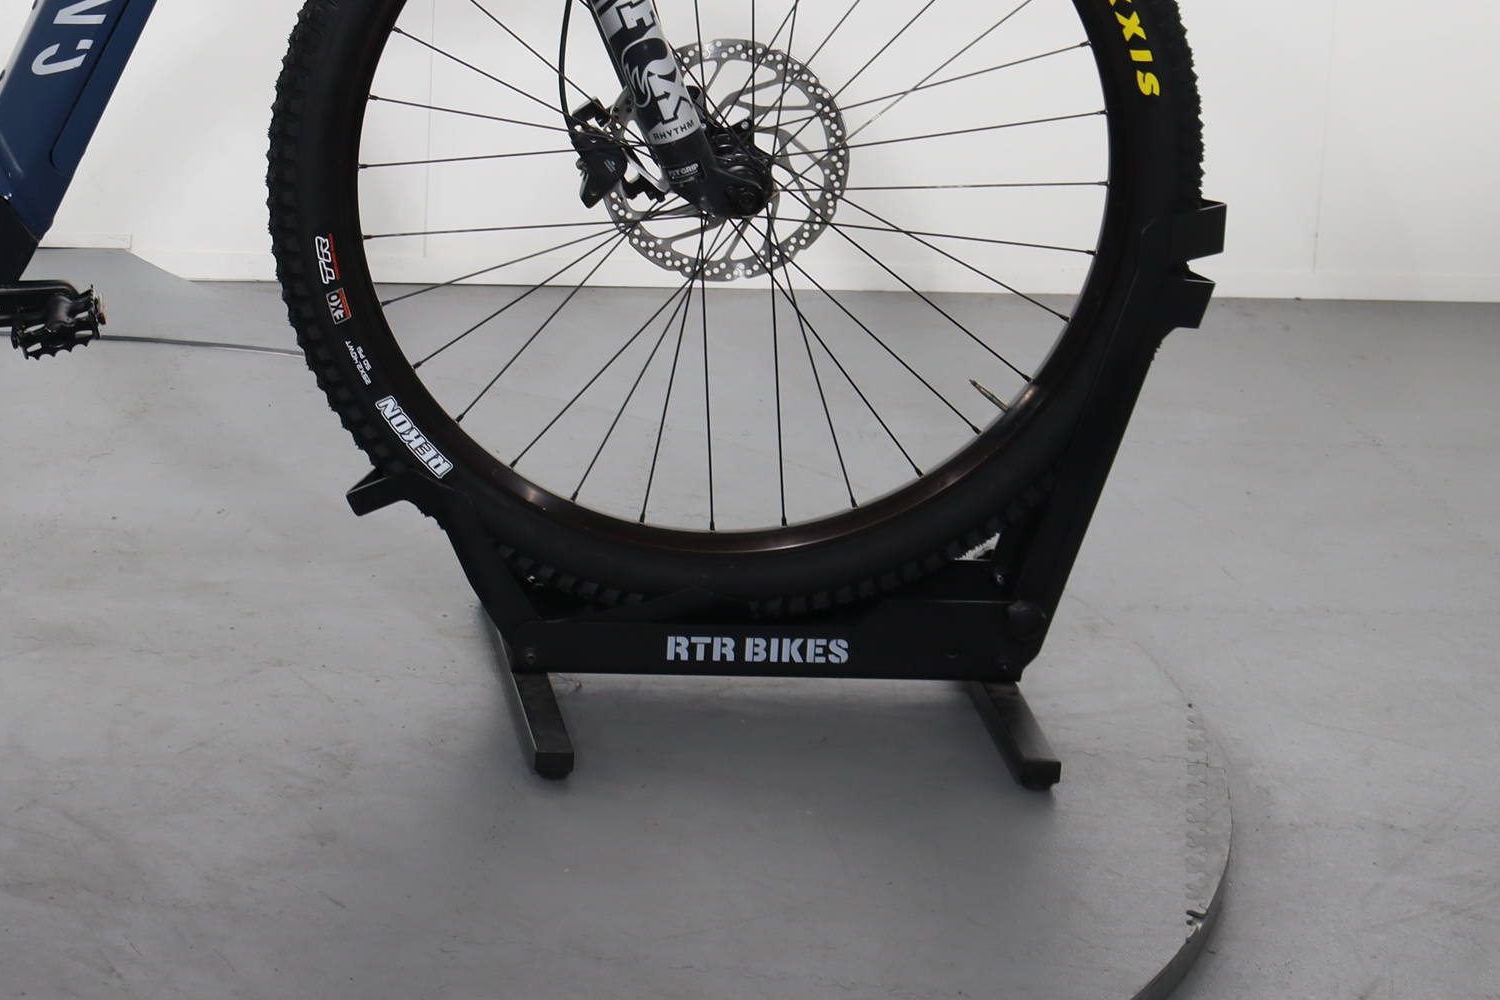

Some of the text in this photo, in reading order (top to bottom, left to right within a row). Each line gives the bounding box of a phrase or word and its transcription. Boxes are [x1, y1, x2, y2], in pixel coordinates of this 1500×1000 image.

[652, 119, 696, 140] RHYTHM
[680, 162, 699, 175] GRIP
[315, 235, 336, 285] TR
[327, 289, 348, 323] EXO
[375, 395, 454, 480] REKON
[666, 636, 849, 664] RTR BIKES
